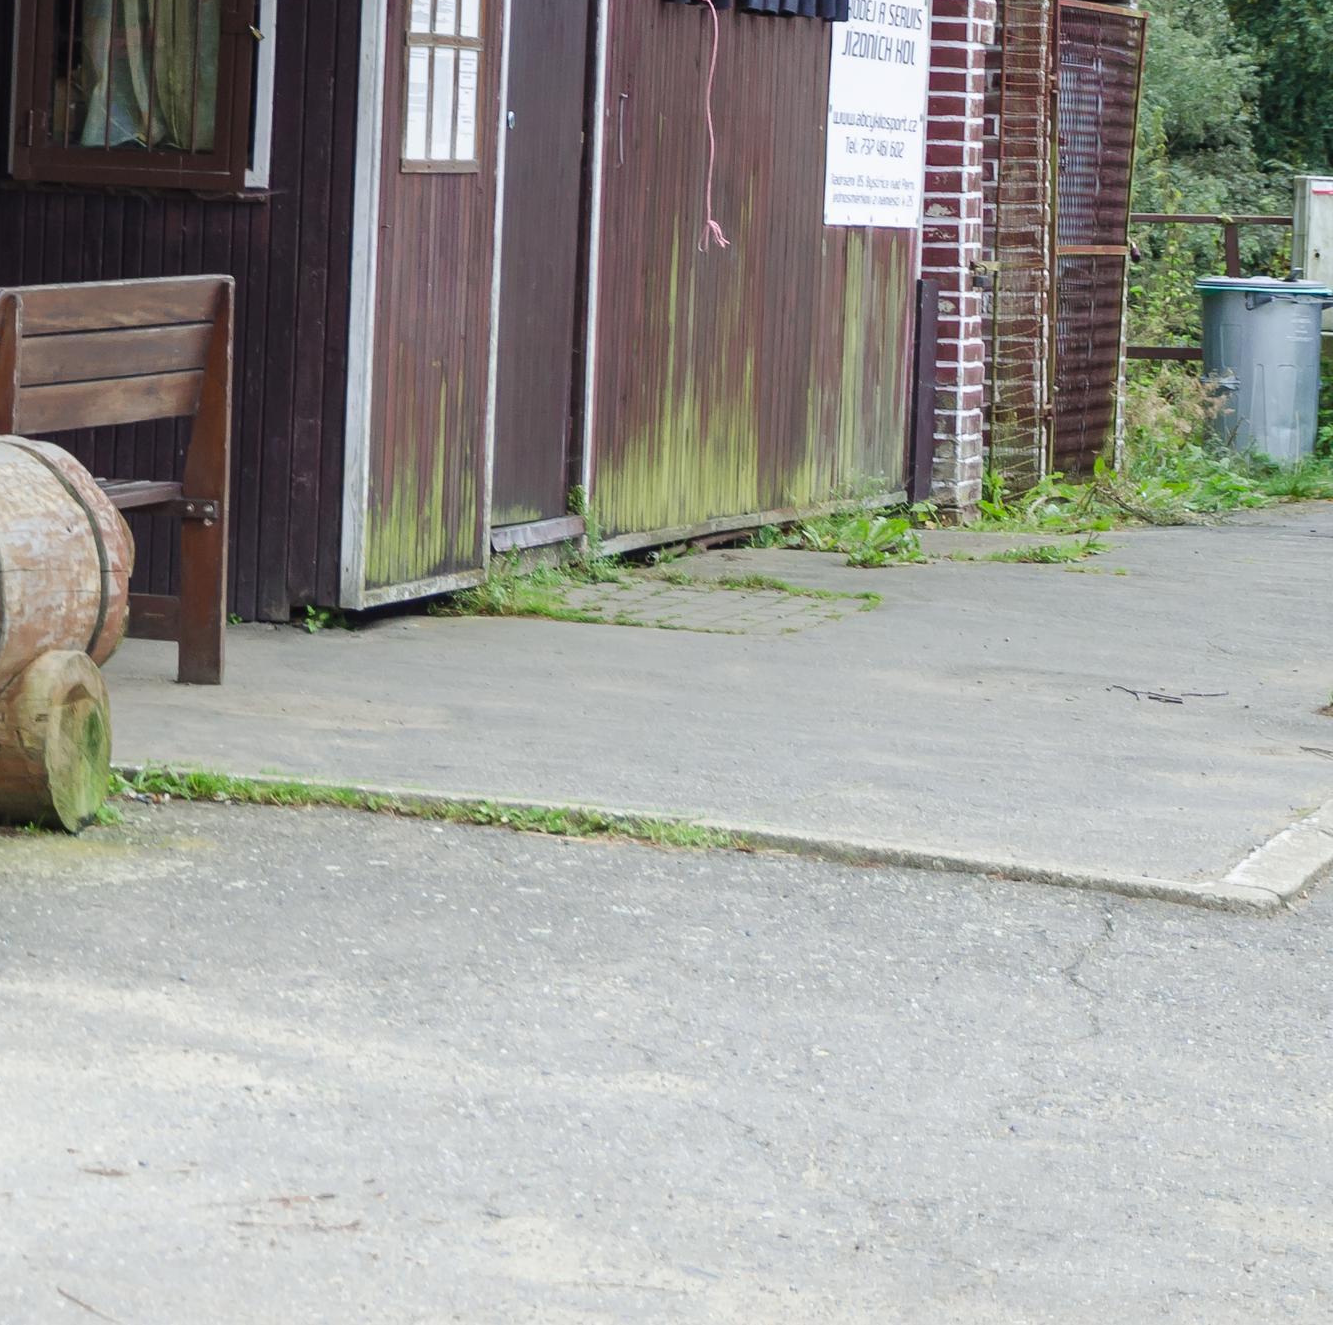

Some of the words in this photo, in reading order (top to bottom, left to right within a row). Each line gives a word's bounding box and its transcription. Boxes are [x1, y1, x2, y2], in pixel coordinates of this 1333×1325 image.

[878, 2, 886, 25] A
[888, 3, 923, 30] SERVIS
[842, 25, 893, 62] JÍZDNÍCH
[895, 37, 915, 66] KOL
